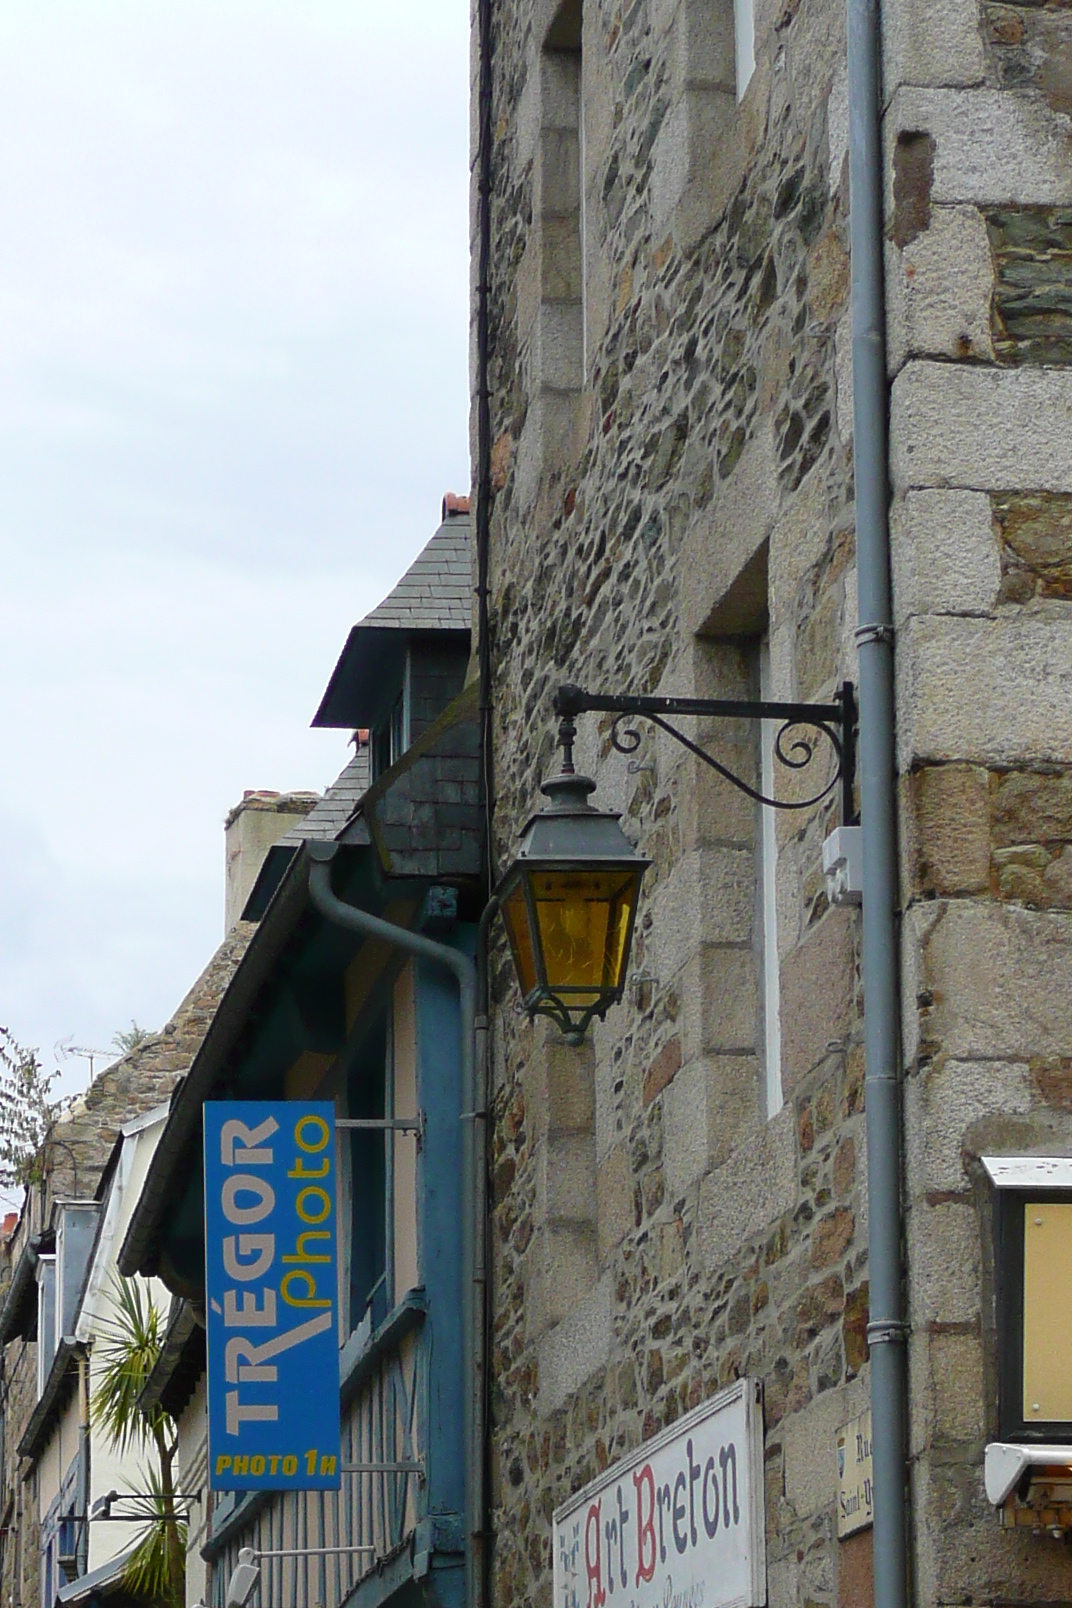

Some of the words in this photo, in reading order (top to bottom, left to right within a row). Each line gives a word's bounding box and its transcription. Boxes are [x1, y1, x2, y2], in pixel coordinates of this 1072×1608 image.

[211, 1115, 332, 1437] TRÉGOR
[280, 1115, 332, 1308] photo
[215, 1454, 298, 1476] PHOTO
[633, 1438, 740, 1588] Breton
